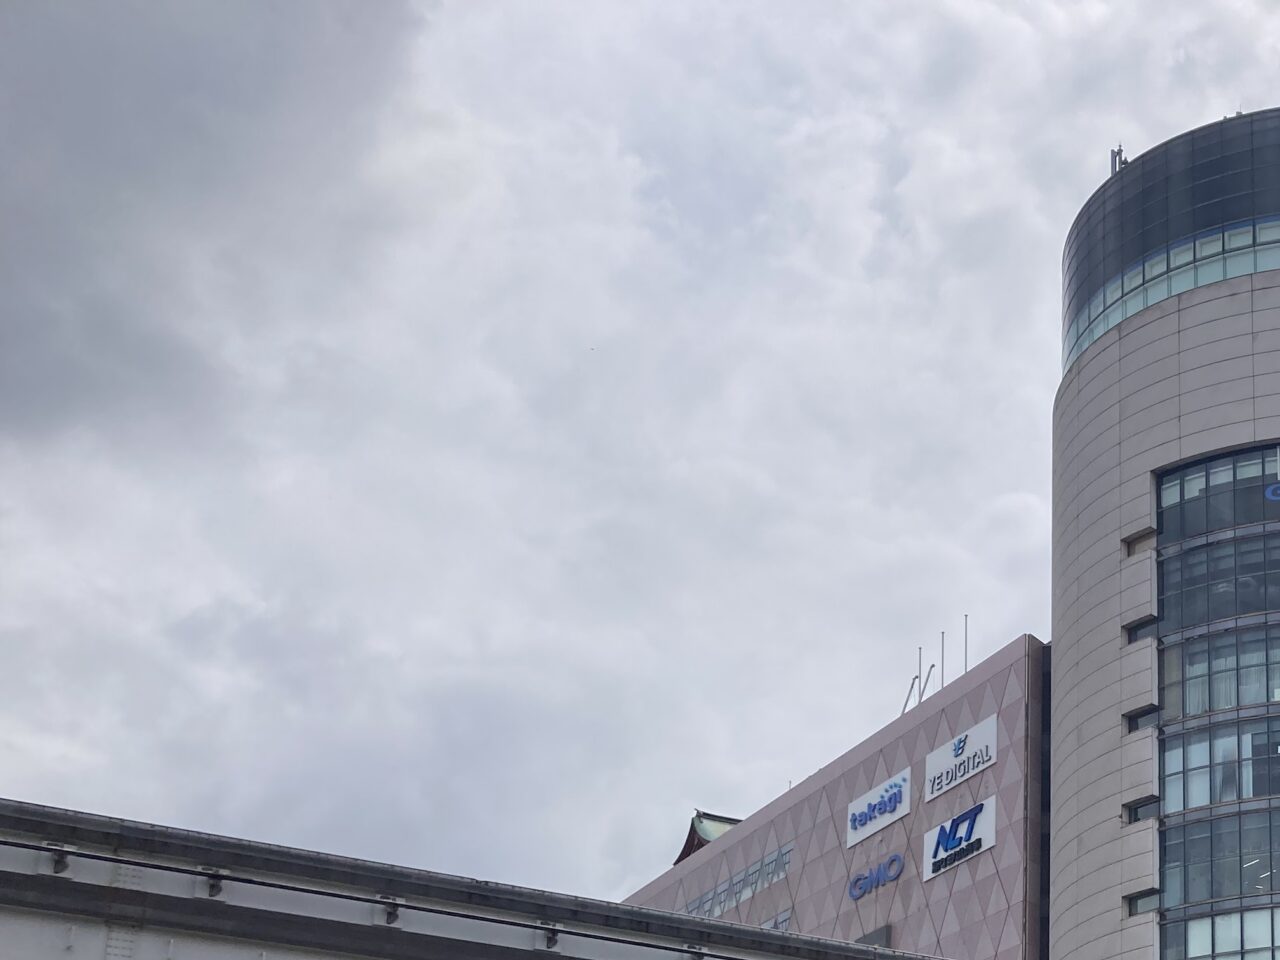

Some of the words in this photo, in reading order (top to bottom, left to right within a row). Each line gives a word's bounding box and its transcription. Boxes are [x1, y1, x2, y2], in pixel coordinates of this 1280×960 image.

[928, 771, 944, 795] YE
[945, 745, 992, 786] DIGITAL
[849, 785, 904, 831] takagi
[849, 854, 905, 900] GMO
